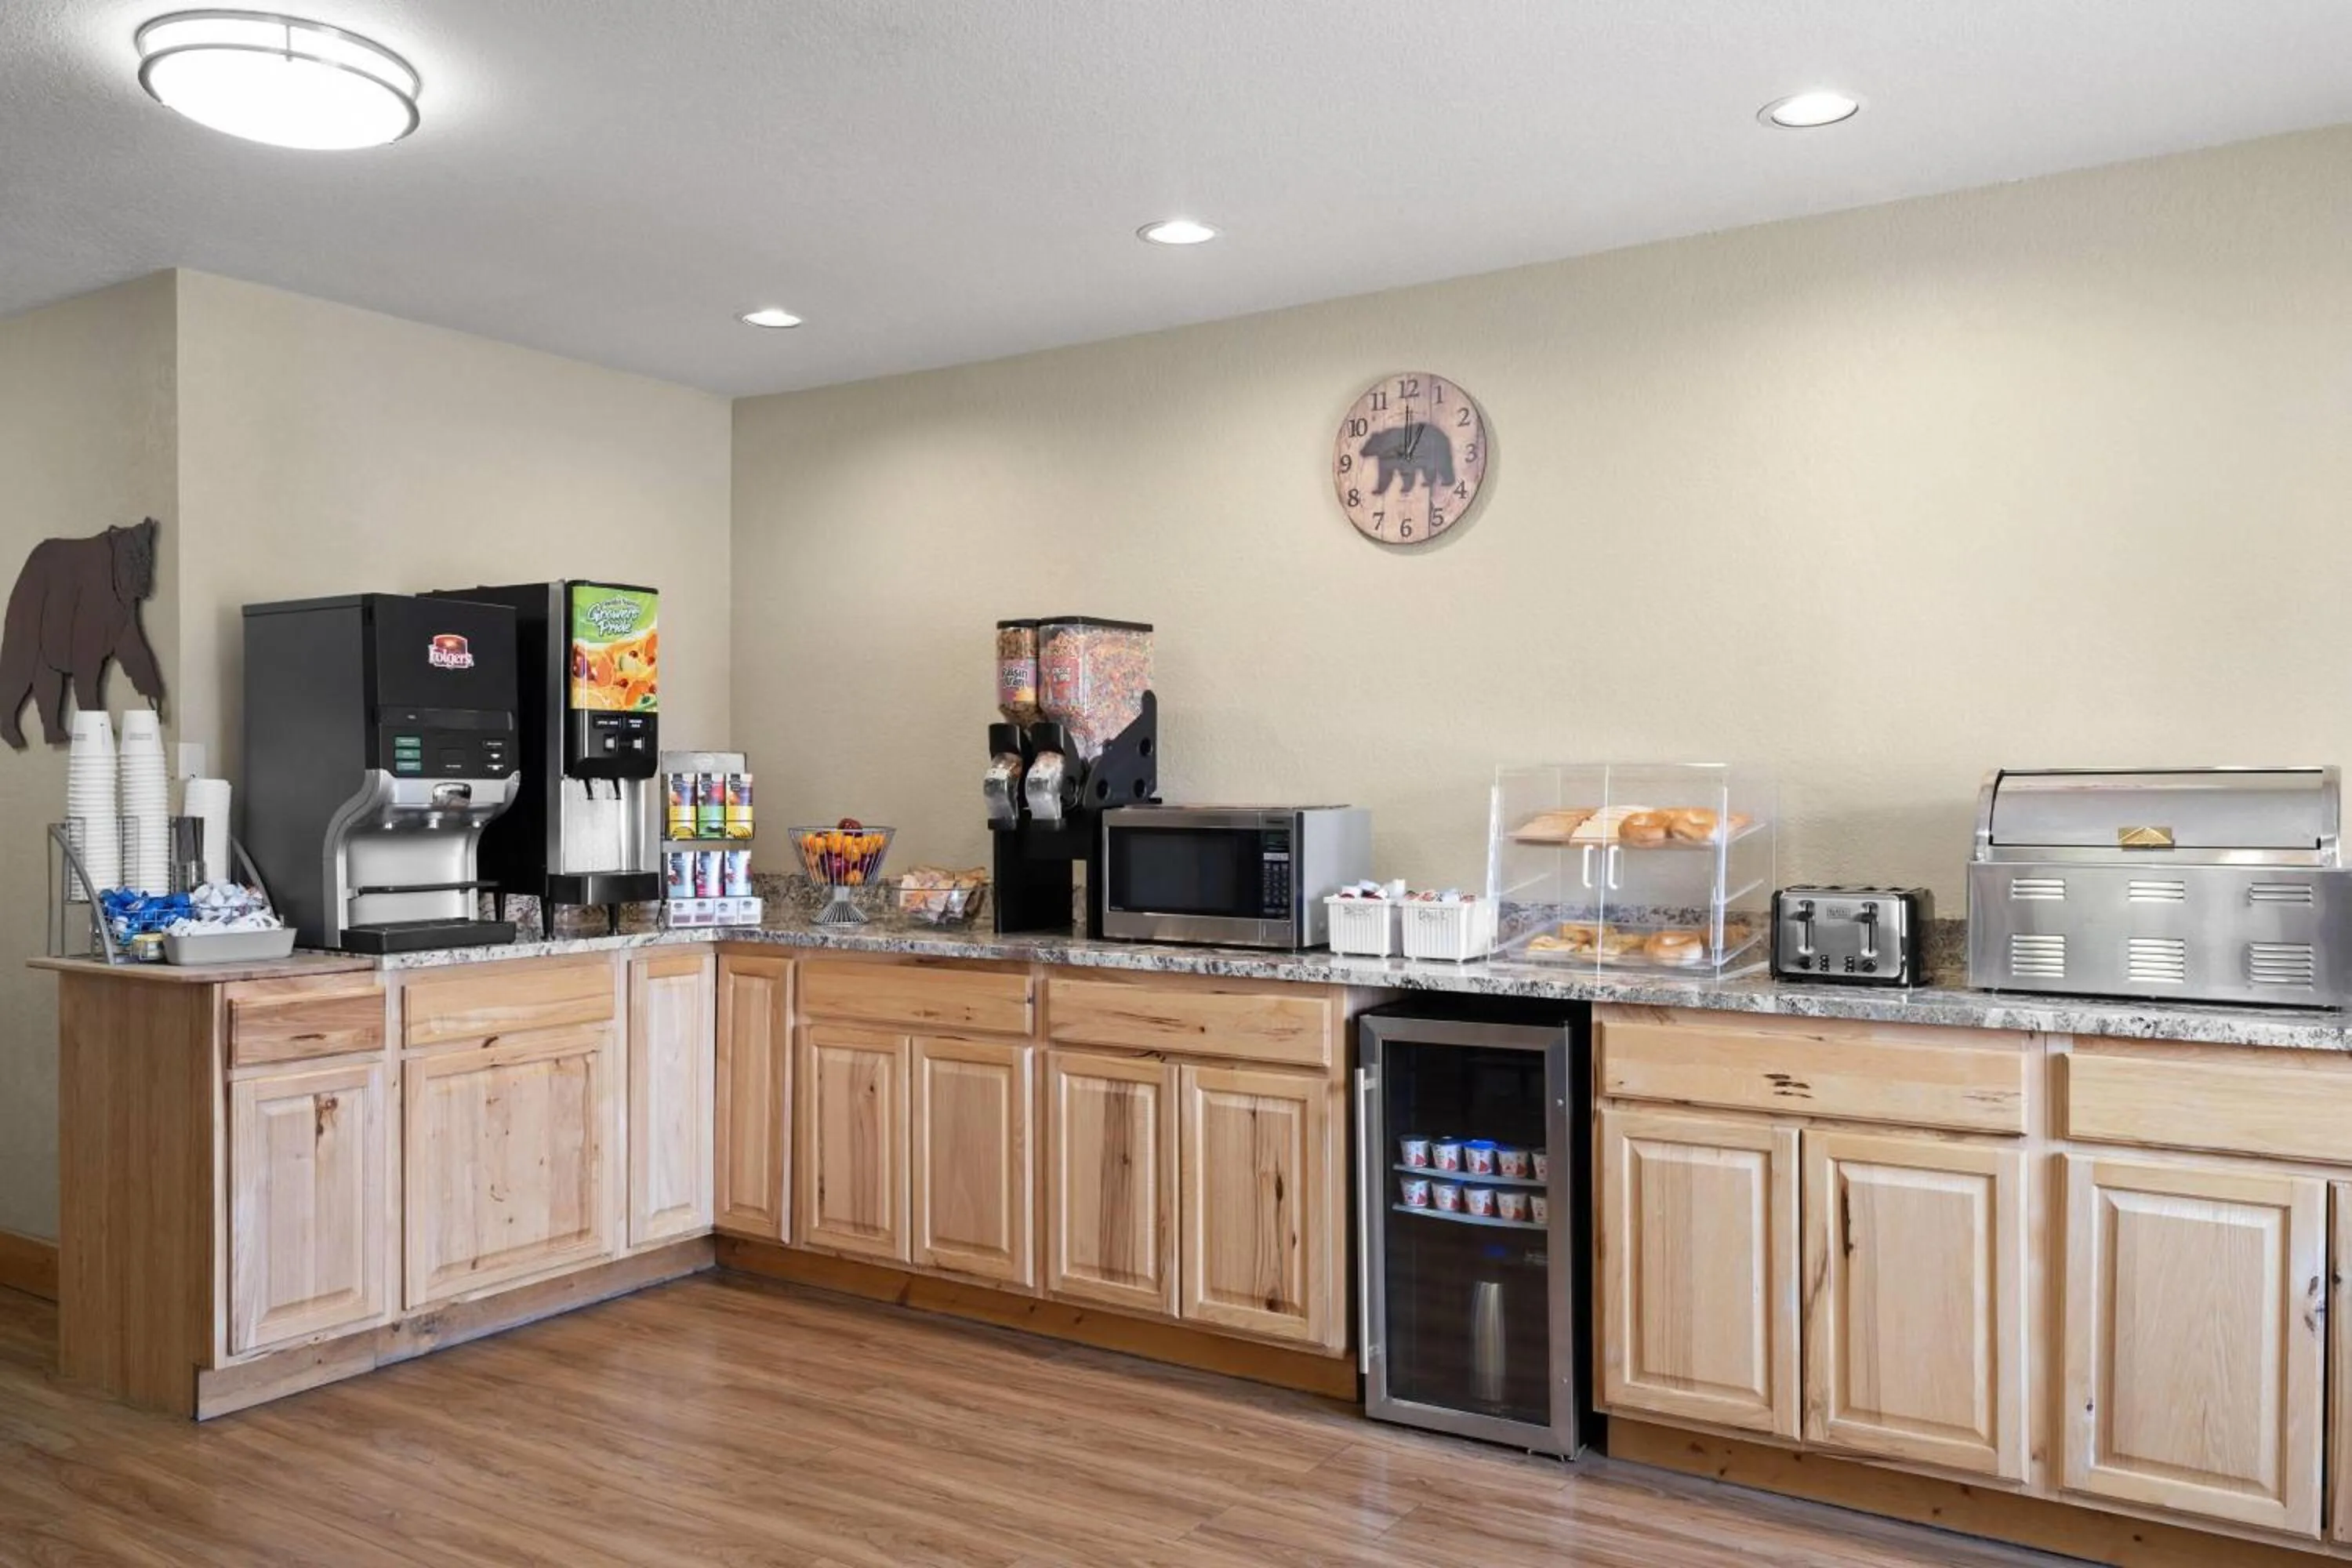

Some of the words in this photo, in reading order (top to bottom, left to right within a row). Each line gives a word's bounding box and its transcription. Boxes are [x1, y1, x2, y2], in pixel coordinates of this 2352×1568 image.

[1398, 379, 1419, 399] 12
[1433, 385, 1443, 404] 1
[1371, 392, 1388, 412] 11
[1457, 407, 1470, 427] 2
[1348, 418, 1368, 437] 10
[1465, 444, 1478, 463] 3
[1339, 454, 1352, 474] 9
[1348, 488, 1359, 507] 8
[1454, 480, 1468, 499] 4
[1373, 512, 1385, 531] 7
[1432, 508, 1444, 527] 5
[1399, 518, 1412, 537] 6
[428, 644, 473, 667] Folgers
